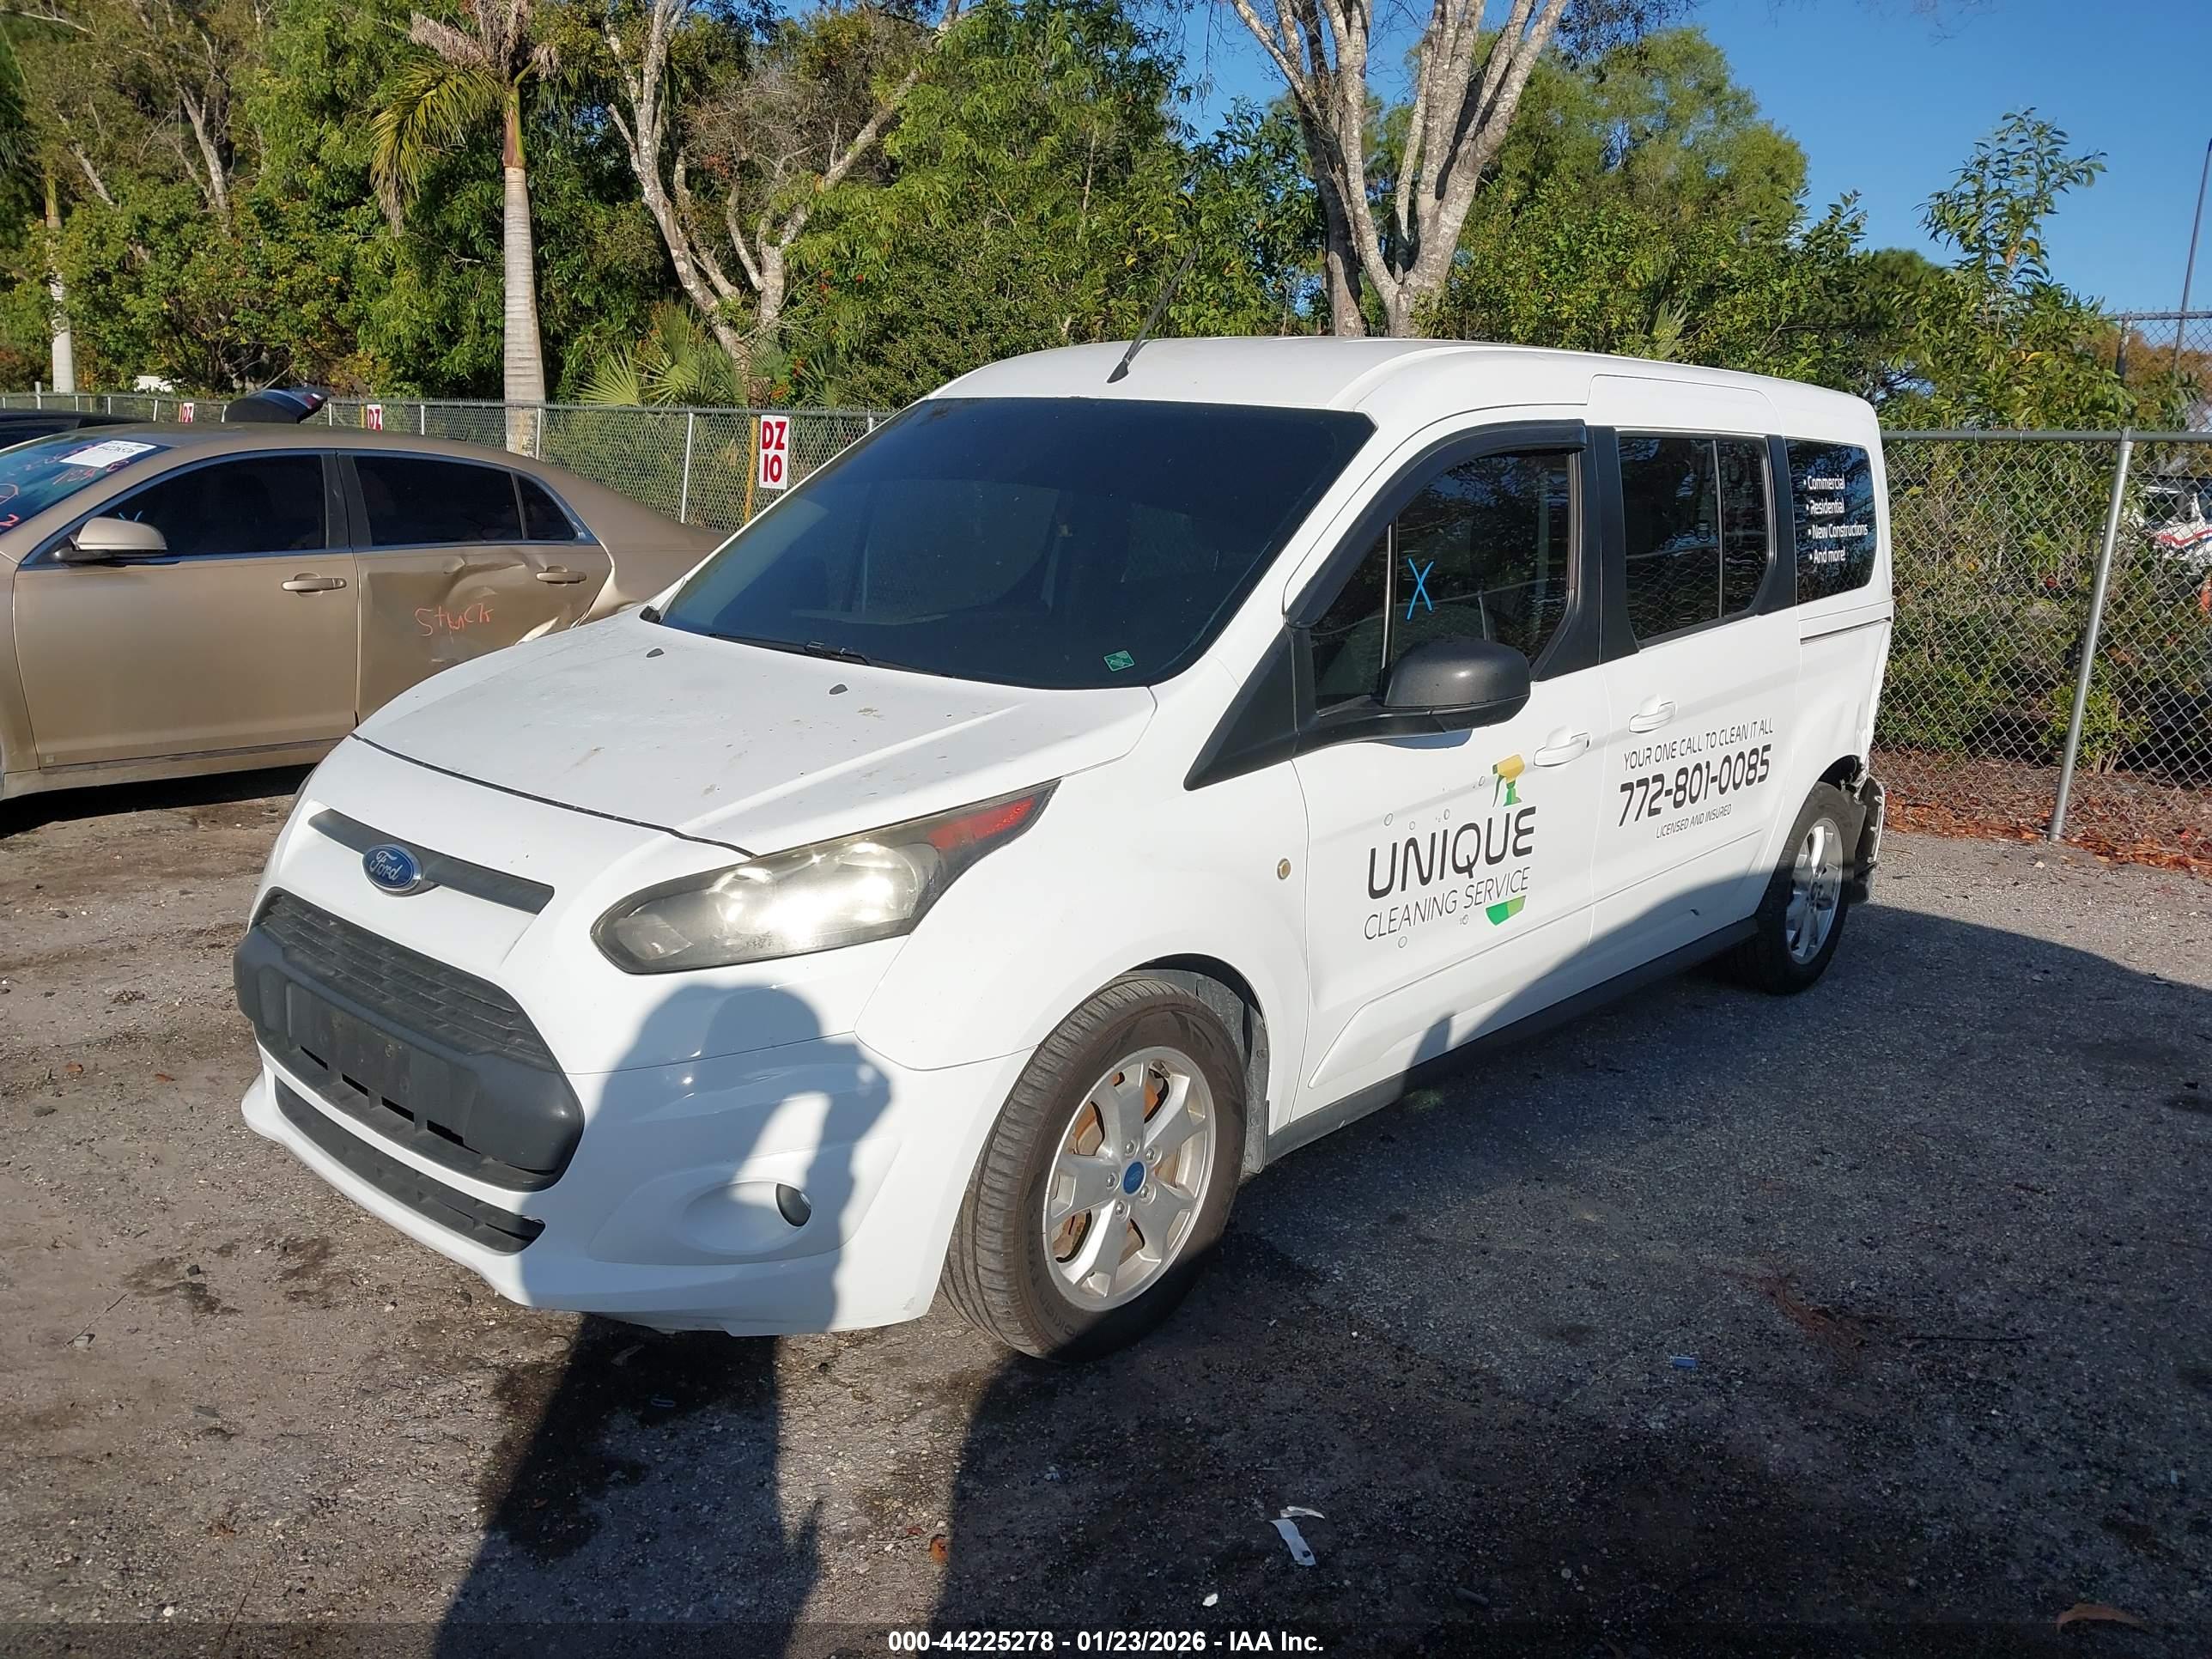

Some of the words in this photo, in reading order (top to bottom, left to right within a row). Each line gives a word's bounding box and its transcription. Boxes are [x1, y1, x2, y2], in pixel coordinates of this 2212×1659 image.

[368, 408, 381, 430] DZ
[762, 421, 787, 450] DZ
[1807, 474, 1845, 489] Commercial
[1810, 497, 1844, 514] Residential
[1812, 524, 1827, 539] New
[1828, 521, 1869, 538] Constructions
[1814, 548, 1826, 564] And
[1828, 547, 1846, 562] more!
[1624, 746, 1652, 771] YOUR
[1655, 741, 1677, 763] ONE
[1680, 734, 1703, 757] CALL
[1705, 731, 1717, 750] TO
[1718, 723, 1749, 745] CLEAN
[1749, 720, 1758, 739] IT
[1759, 717, 1774, 734] ALL
[1618, 743, 1772, 828] 772-801-0085
[1656, 818, 1690, 839] LICENSED
[1690, 812, 1705, 826] AND
[1705, 804, 1732, 822] INSURED
[369, 850, 404, 881] Ford
[1367, 805, 1537, 900] UNIQUE
[1364, 889, 1459, 940] CLEANING
[1463, 866, 1531, 909] SERVICE
